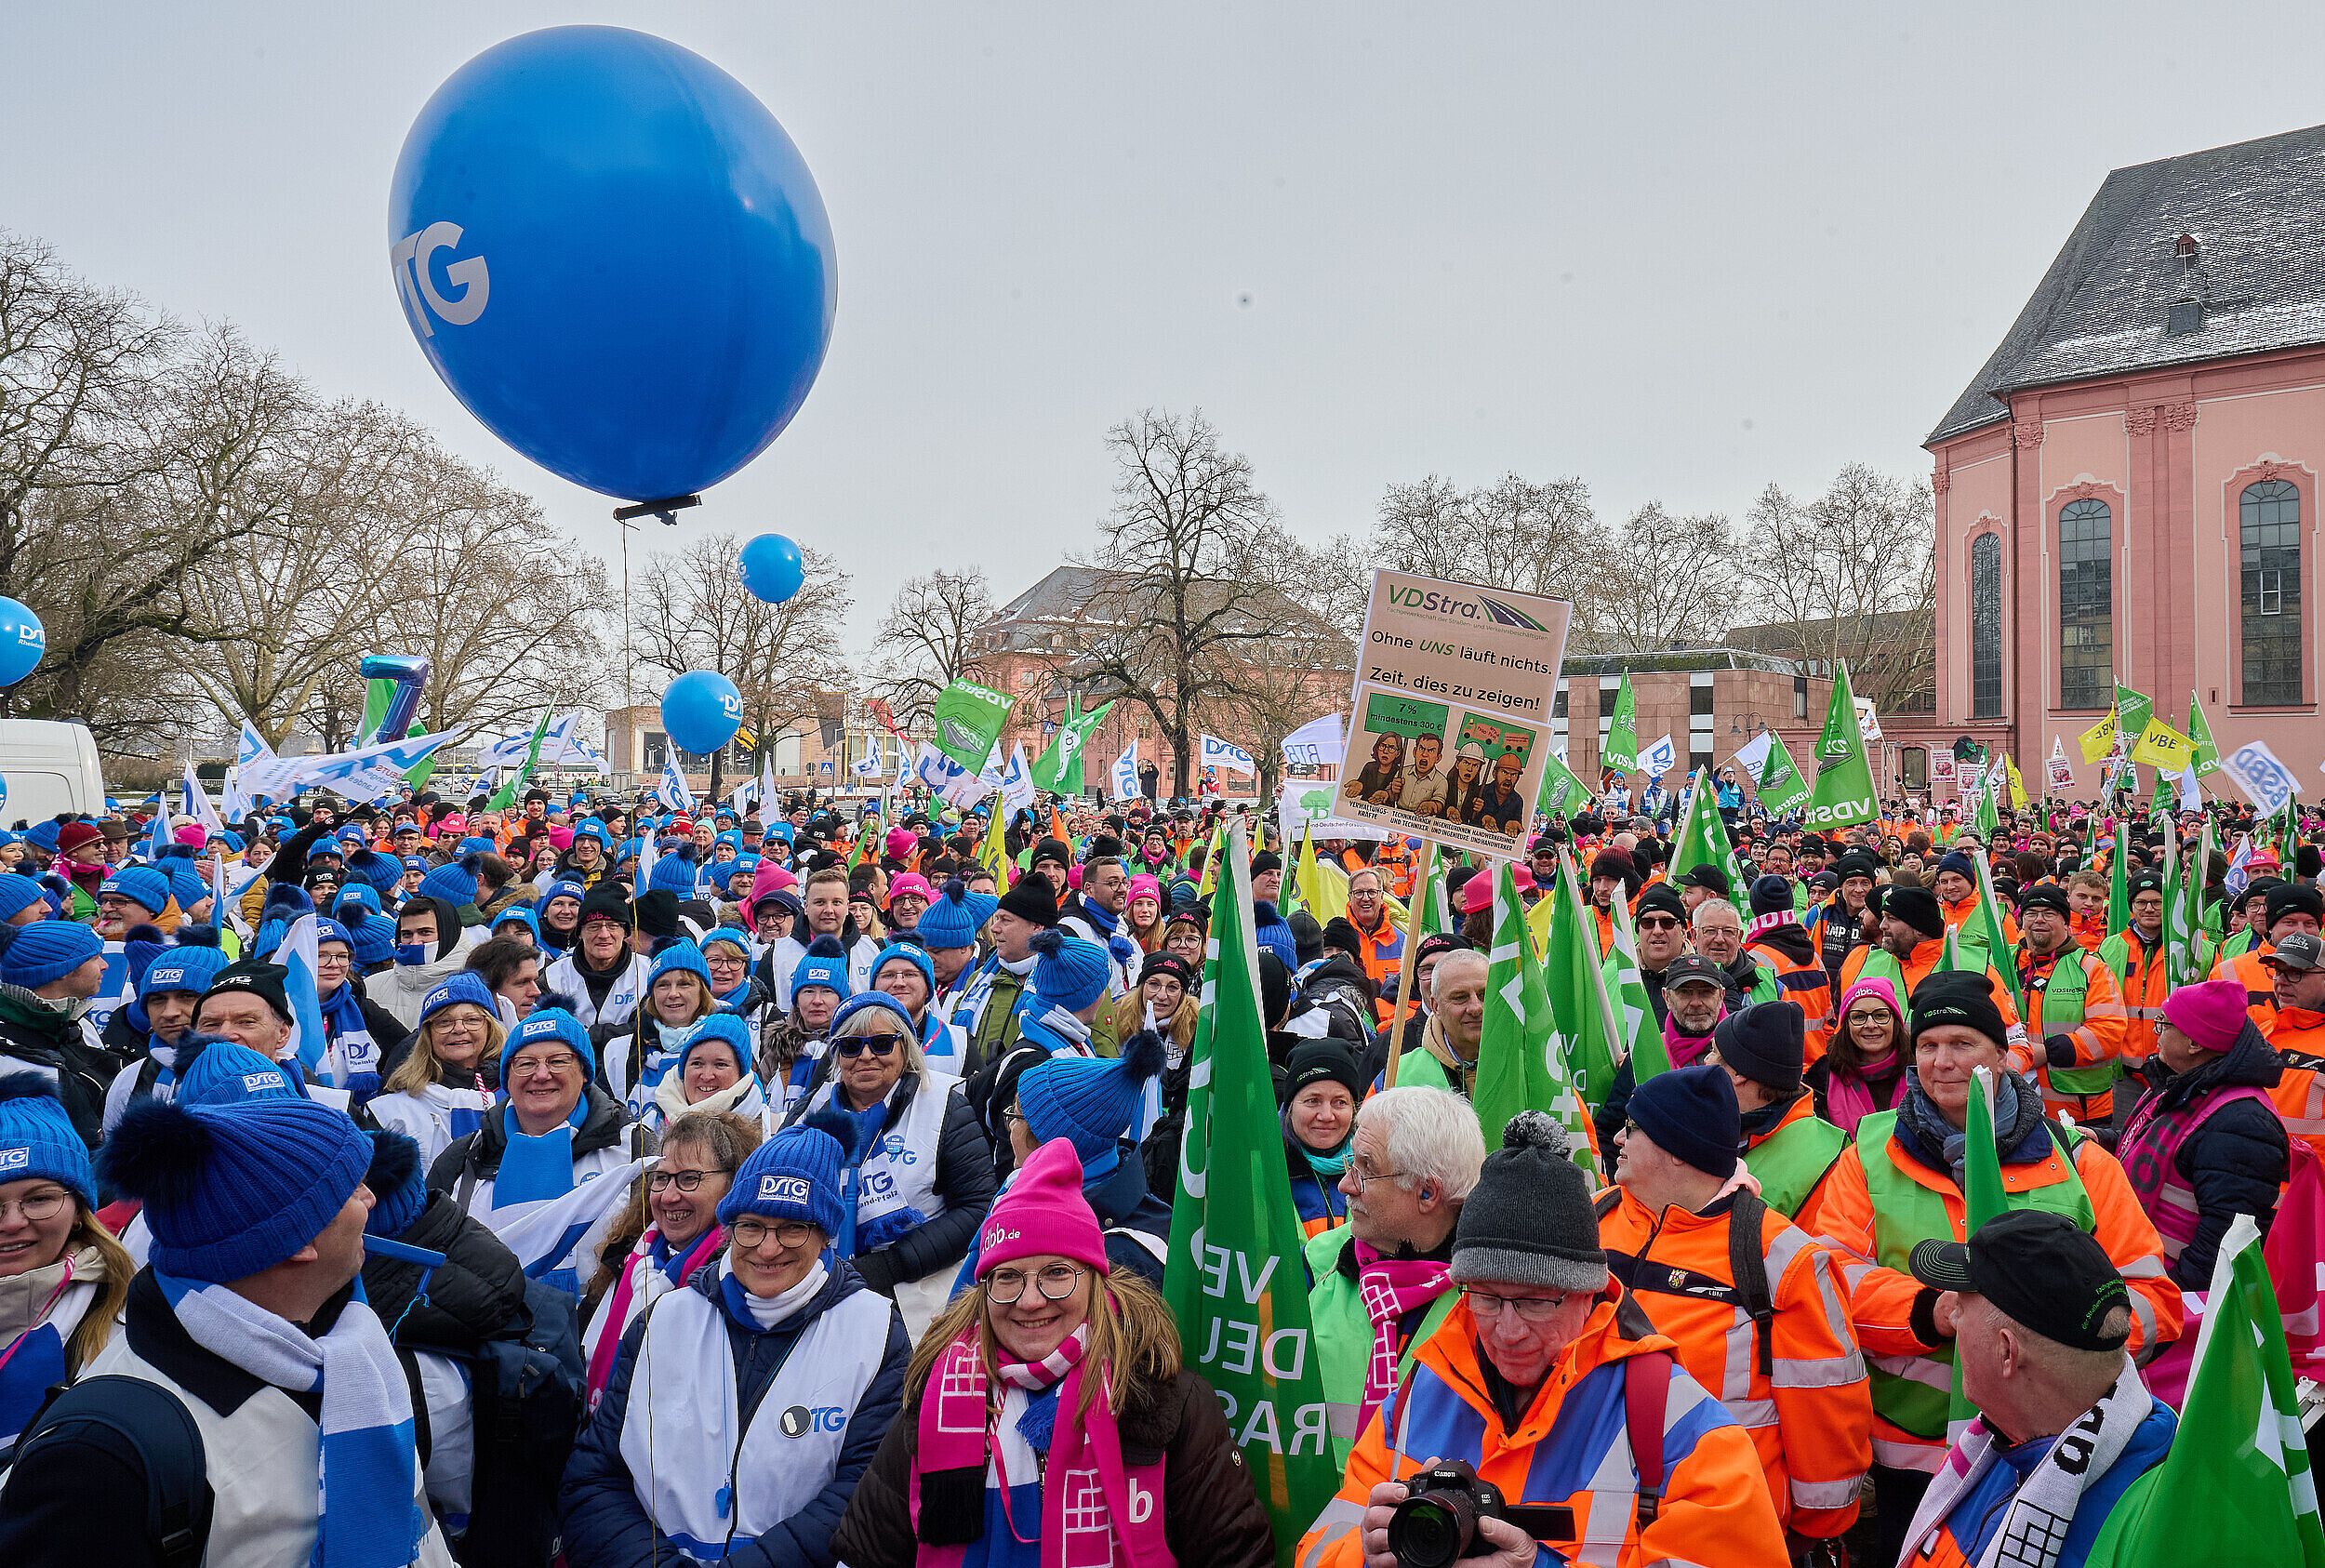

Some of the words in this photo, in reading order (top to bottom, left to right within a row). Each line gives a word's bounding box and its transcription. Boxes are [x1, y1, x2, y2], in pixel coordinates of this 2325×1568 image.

[1387, 606, 1437, 622] Fachgewerkschaft
[1372, 631, 1414, 648] Ohne
[1419, 639, 1455, 656] UNS
[1459, 645, 1496, 665] läuft
[1500, 655, 1552, 675] nichts.
[1369, 666, 1408, 688] Zeit,
[1413, 674, 1448, 694] dies
[1452, 684, 1473, 698] zu
[1476, 689, 1540, 711] zeigen!
[1370, 713, 1418, 728] mindestens
[1419, 720, 1435, 730] 300
[2148, 731, 2179, 750] VBE
[1206, 738, 1252, 762] DSTG
[1349, 800, 1388, 816] VERWALTUNGS-
[1357, 809, 1378, 820] KRÄFTE
[153, 970, 182, 979] DSTG
[525, 1021, 555, 1034] DSTG
[245, 1073, 279, 1087] DSTG
[764, 1178, 808, 1196] DSTG
[1434, 1469, 1456, 1478] Canon
